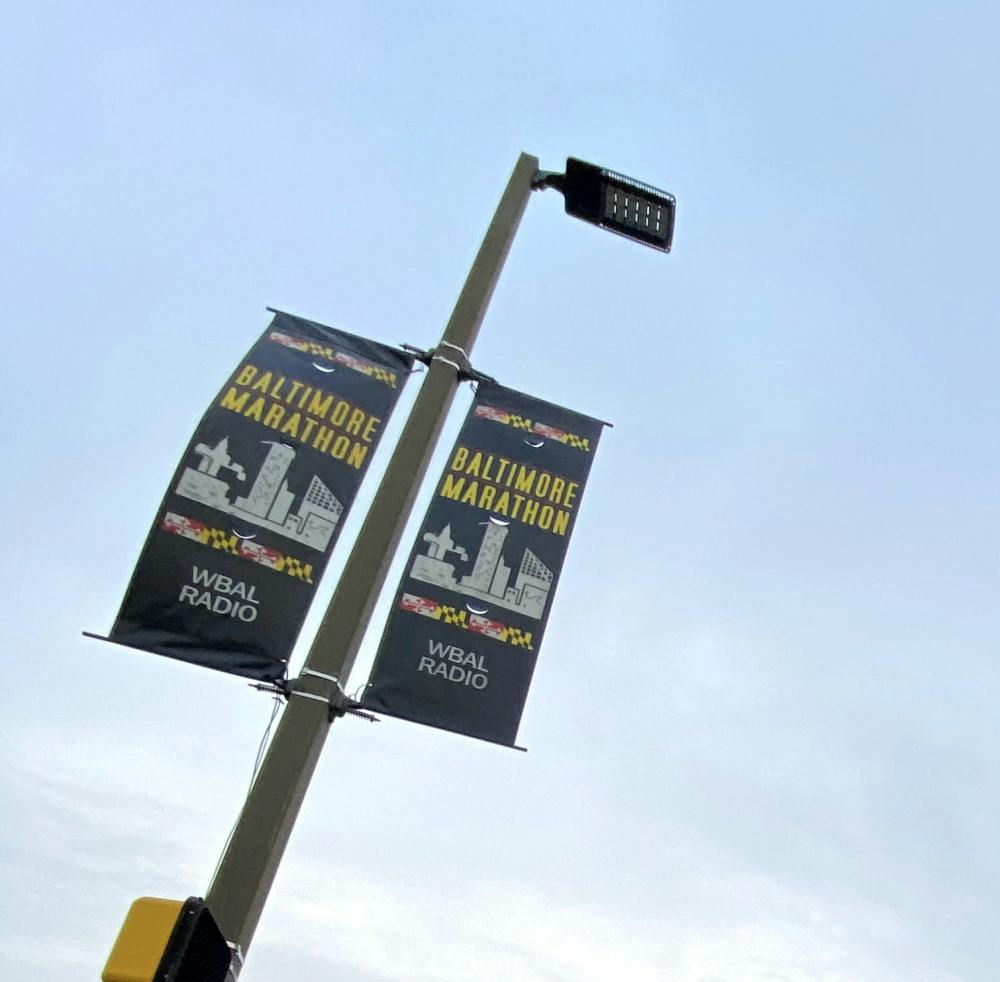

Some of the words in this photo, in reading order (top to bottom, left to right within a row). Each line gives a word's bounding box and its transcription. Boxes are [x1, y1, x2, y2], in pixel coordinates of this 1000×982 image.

[220, 387, 368, 470] MARATHON
[235, 364, 382, 443] BALTIMORE
[451, 447, 579, 509] BALTIMORE
[440, 474, 570, 536] MARATHON
[178, 585, 258, 622] RADIO
[192, 565, 260, 605] WBAL
[418, 656, 489, 690] RADIO
[429, 639, 489, 673] WBAL
